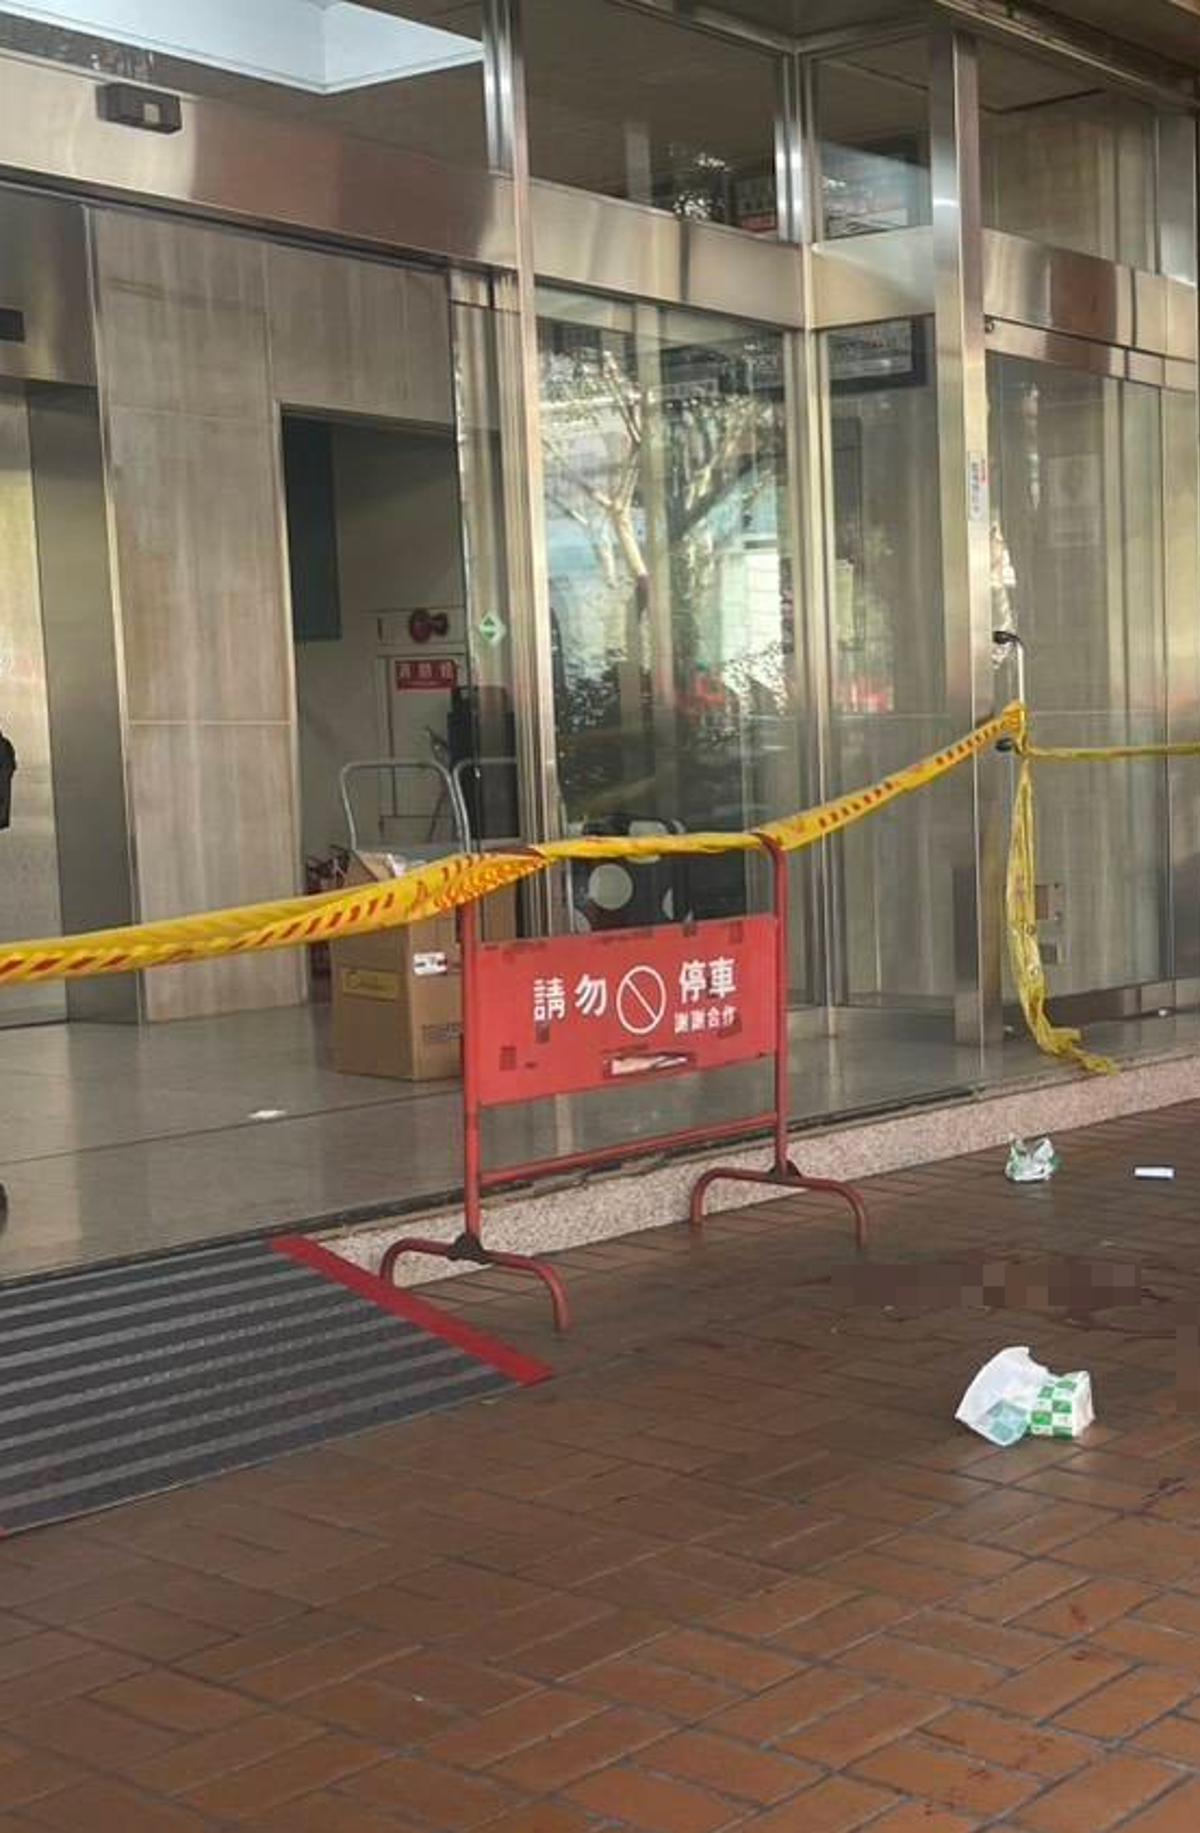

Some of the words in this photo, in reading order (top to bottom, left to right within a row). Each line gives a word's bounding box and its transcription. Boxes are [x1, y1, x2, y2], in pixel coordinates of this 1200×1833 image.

[533, 973, 608, 1021] 請勿
[678, 956, 737, 1004] 停車
[674, 1006, 738, 1034] 謝謝合作
